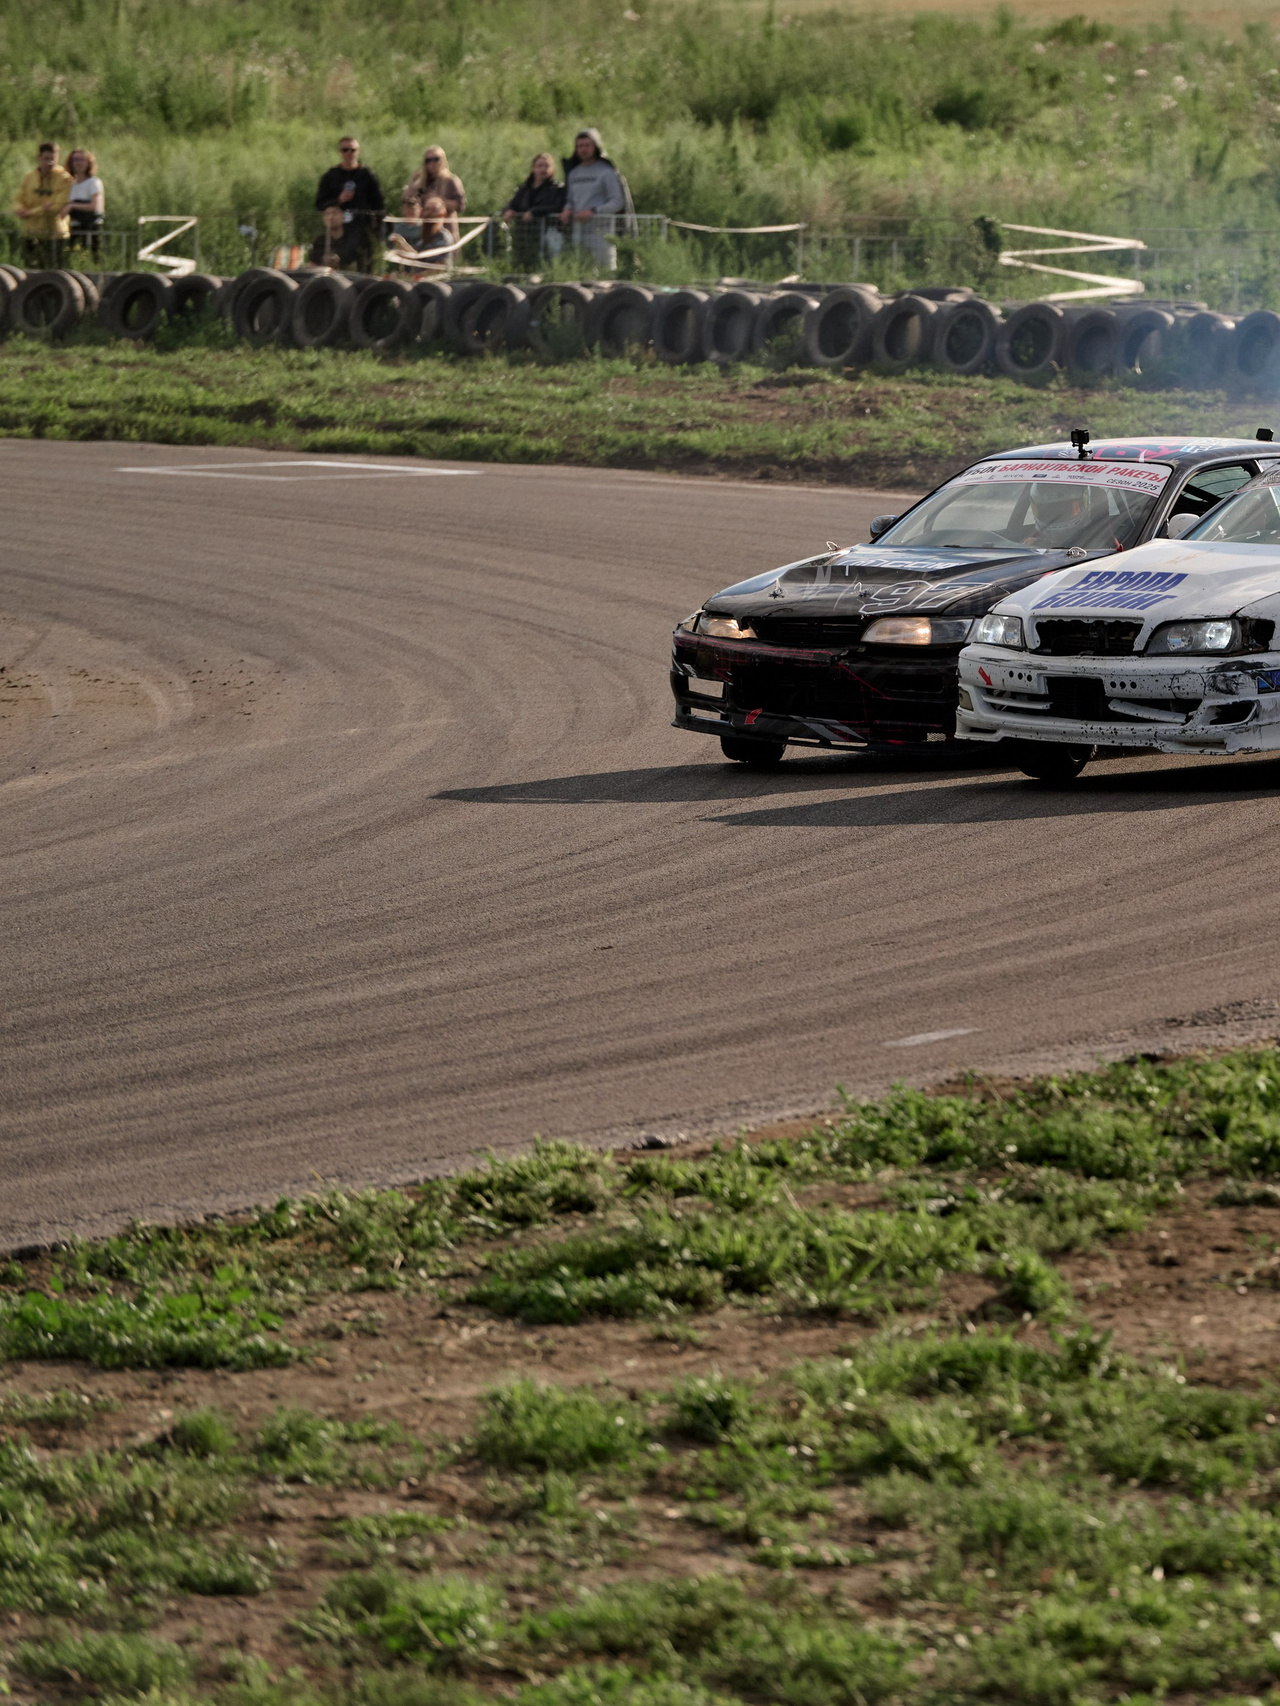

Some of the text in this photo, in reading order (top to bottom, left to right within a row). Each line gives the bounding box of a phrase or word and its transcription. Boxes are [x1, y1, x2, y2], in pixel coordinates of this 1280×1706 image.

[998, 463, 1107, 474] БАРНАУЛЬСКОЙ
[1106, 467, 1169, 483] РАКЕТЫ
[1106, 478, 1161, 491] СЕЗОН 2025
[1064, 571, 1189, 592] ЕВРОПА
[859, 580, 992, 614] 97
[1031, 592, 1177, 610] БОУЛИНГ
